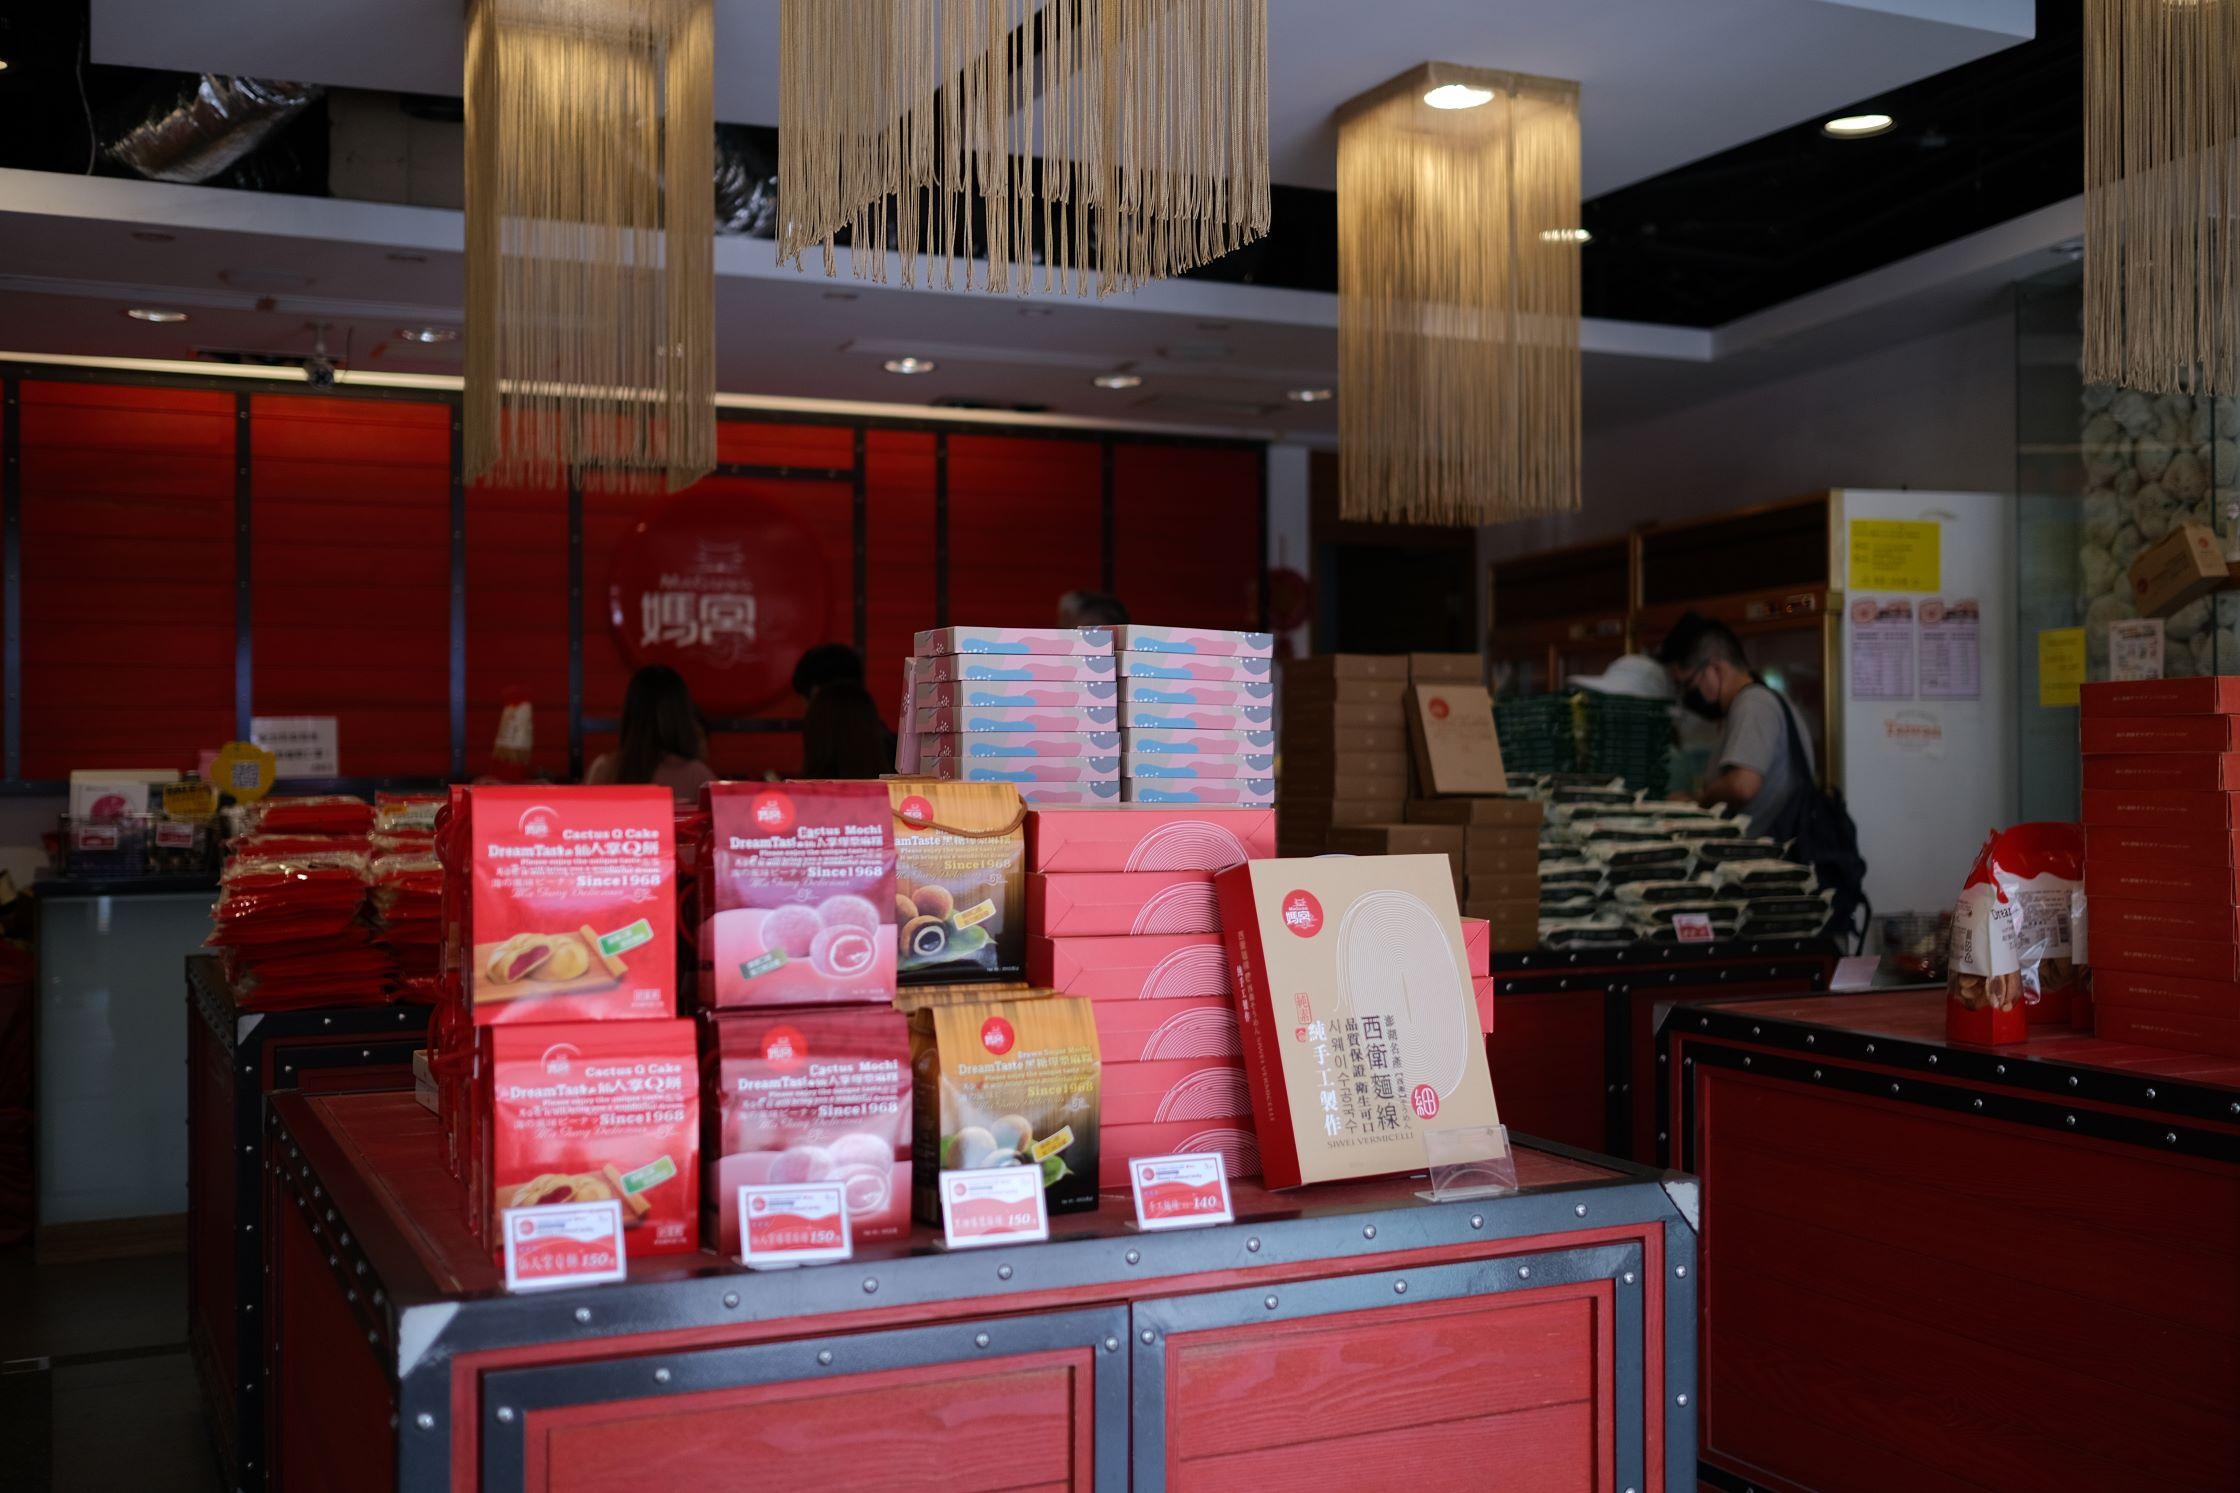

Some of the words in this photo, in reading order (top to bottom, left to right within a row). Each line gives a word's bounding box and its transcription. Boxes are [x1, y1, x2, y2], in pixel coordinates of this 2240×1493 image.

[562, 828, 609, 840] Cactus
[625, 828, 660, 840] Cake
[797, 826, 840, 838] Cactus
[844, 825, 883, 835] Mochi
[895, 836, 941, 846] amTaste
[807, 866, 883, 877] Since1968
[576, 874, 661, 887] Since1968
[809, 1063, 854, 1076] Cactus
[859, 1059, 898, 1071] Mochi
[1193, 1196, 1217, 1209] 140
[1008, 1213, 1031, 1226] 150
[810, 1230, 835, 1242] 150
